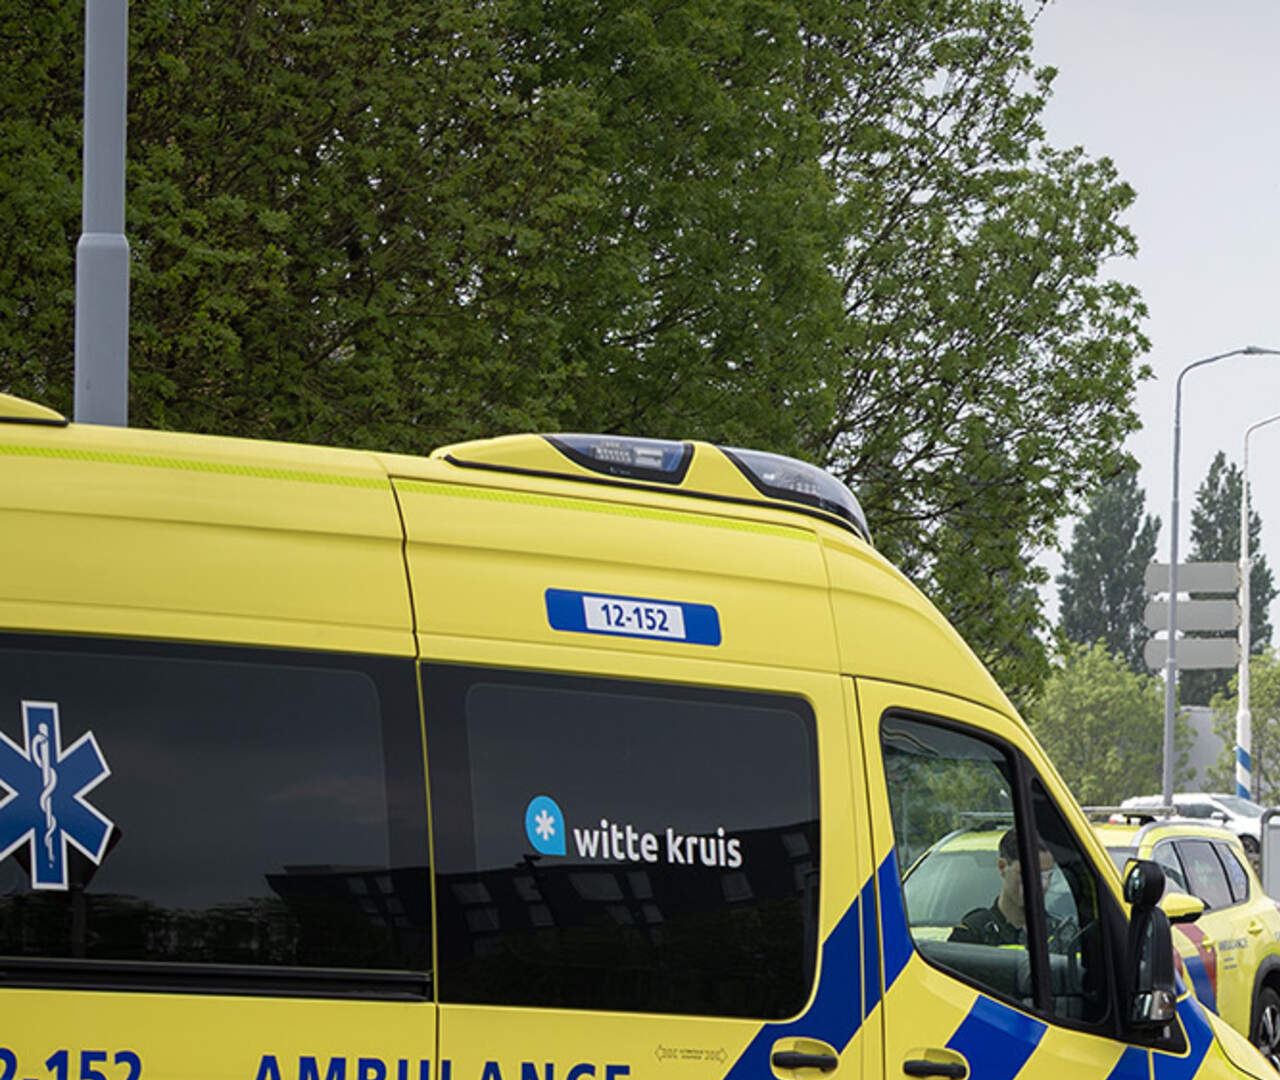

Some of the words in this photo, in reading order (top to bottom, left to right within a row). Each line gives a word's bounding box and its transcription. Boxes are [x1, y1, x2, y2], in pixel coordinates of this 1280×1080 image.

[600, 603, 670, 632] 12-152
[573, 818, 660, 863] witte
[666, 826, 743, 868] kruis
